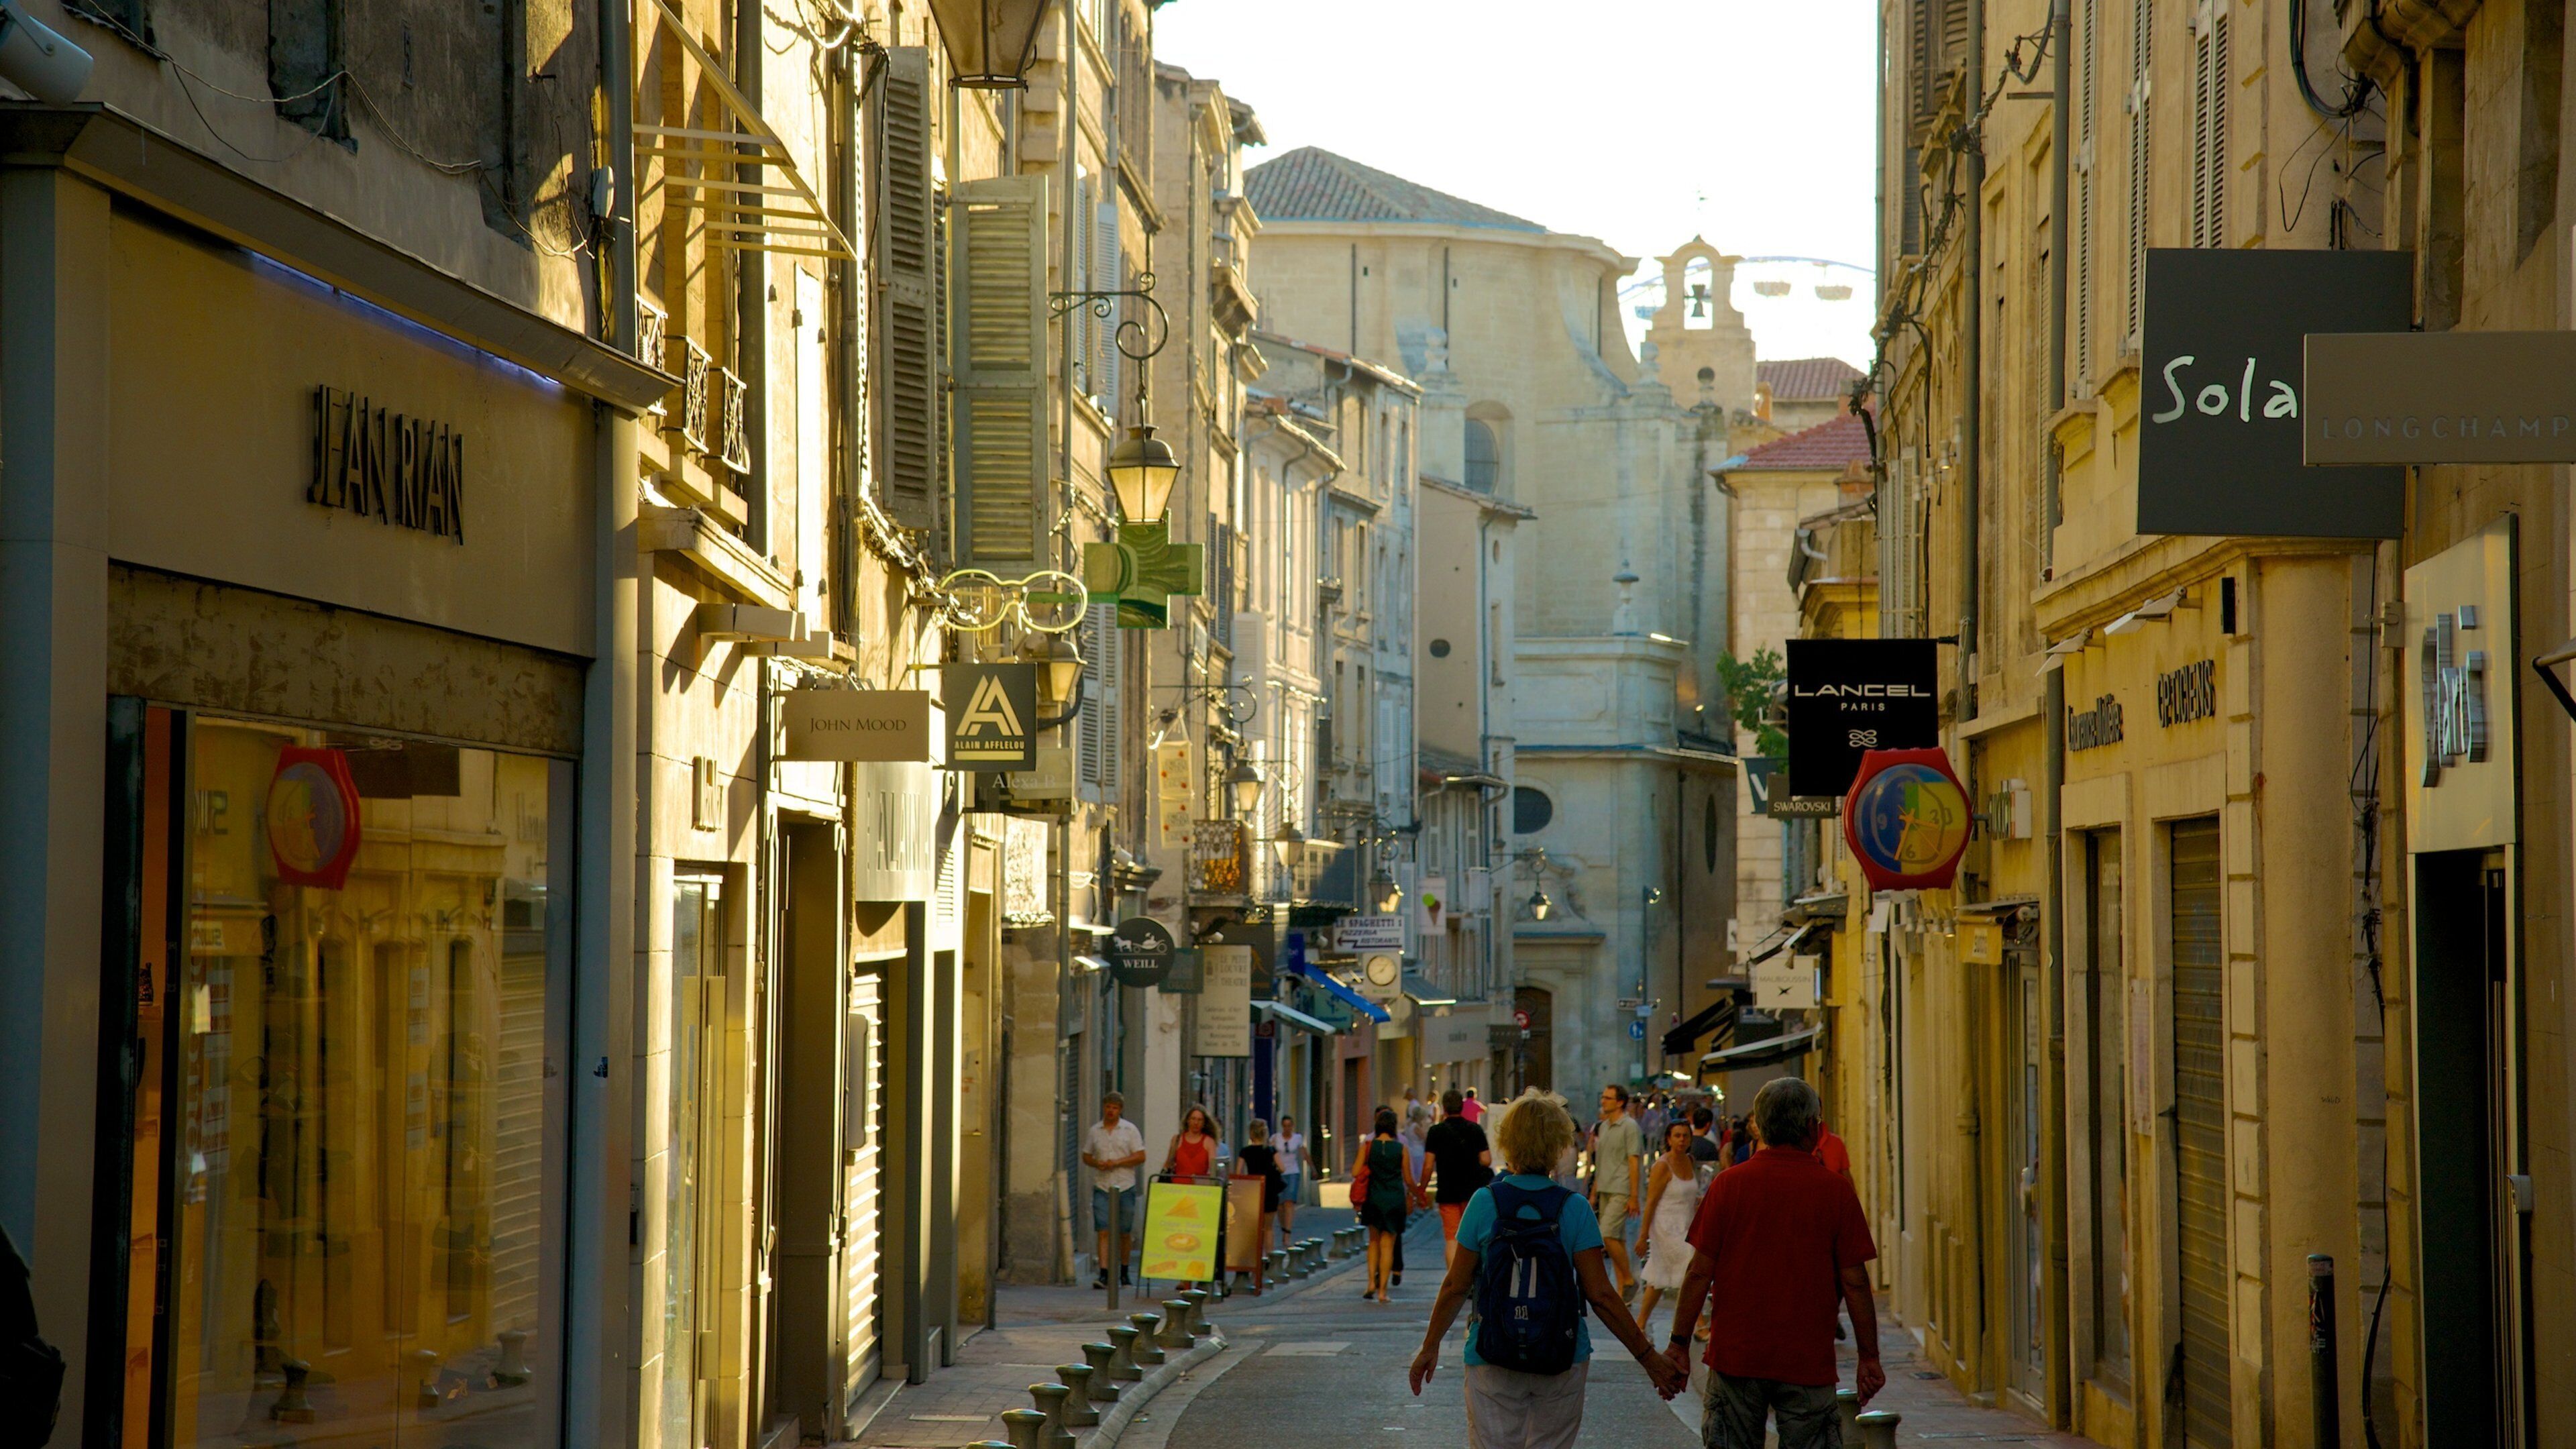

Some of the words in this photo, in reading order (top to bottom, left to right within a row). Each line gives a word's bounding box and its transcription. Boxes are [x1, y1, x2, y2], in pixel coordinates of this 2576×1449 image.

[2151, 355, 2298, 424] Sola
[2323, 417, 2570, 439] LONGCHAMP
[307, 384, 389, 525] JEAN
[1795, 684, 1931, 697] LANCEL
[2157, 659, 2216, 728] OPTICIENS
[1841, 702, 1886, 711] PARIS
[810, 717, 851, 733] JOHN
[856, 717, 907, 732] MOOD
[955, 741, 980, 749] ALAIN
[984, 741, 1025, 749] AFFLELOU
[992, 773, 1038, 789] Alexa
[1774, 801, 1831, 812] SWAROVSKI
[1335, 918, 1345, 928] LE
[1348, 918, 1395, 927] SPAGHETTI
[1122, 959, 1159, 969] WEILL
